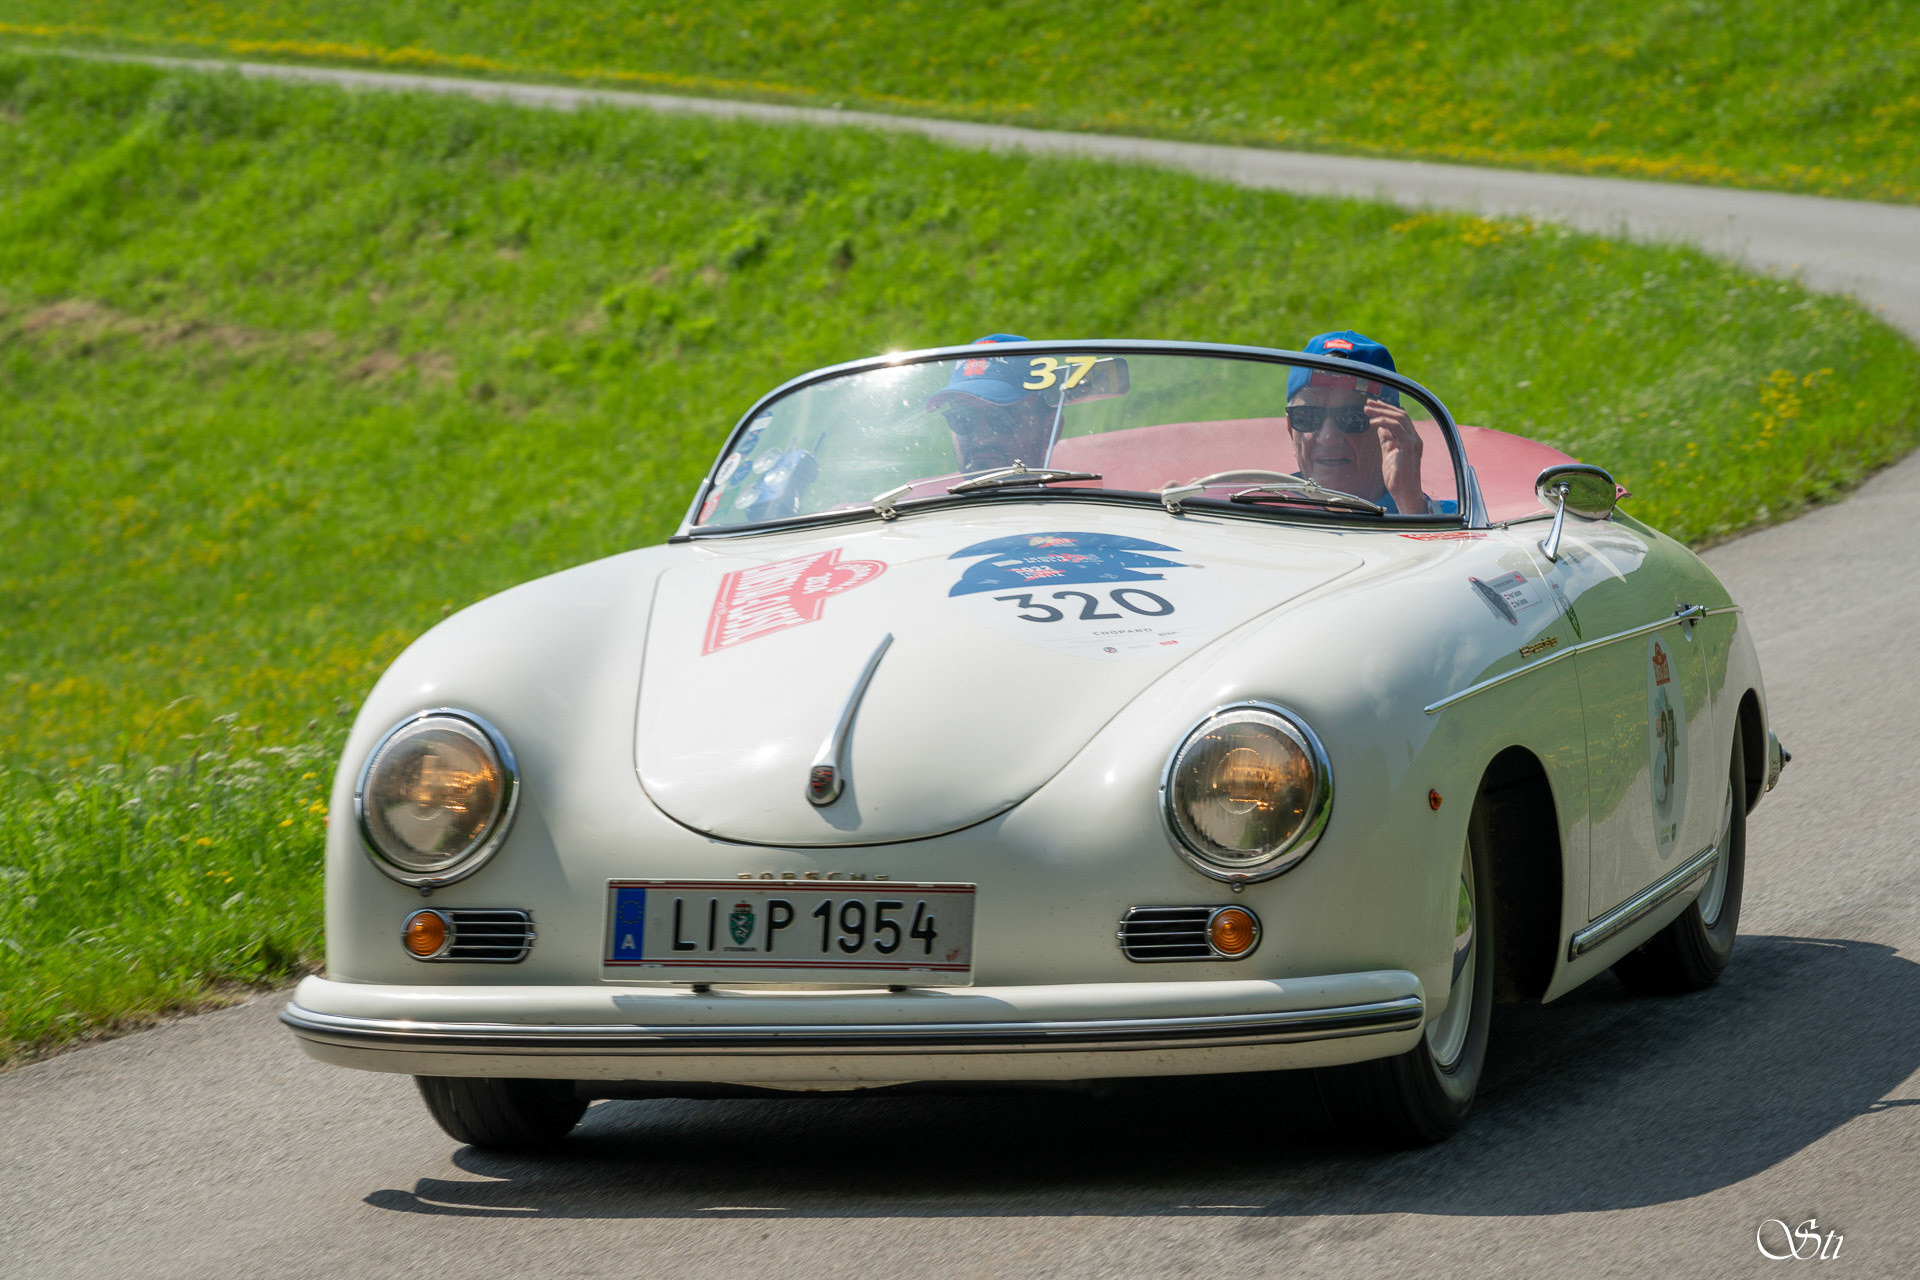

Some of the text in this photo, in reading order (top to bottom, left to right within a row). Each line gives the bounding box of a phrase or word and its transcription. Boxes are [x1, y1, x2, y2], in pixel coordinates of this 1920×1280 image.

[1022, 356, 1097, 390] 37
[993, 588, 1175, 623] 320
[1092, 627, 1154, 636] CHOPARD
[620, 933, 637, 950] A
[671, 897, 718, 952] LI
